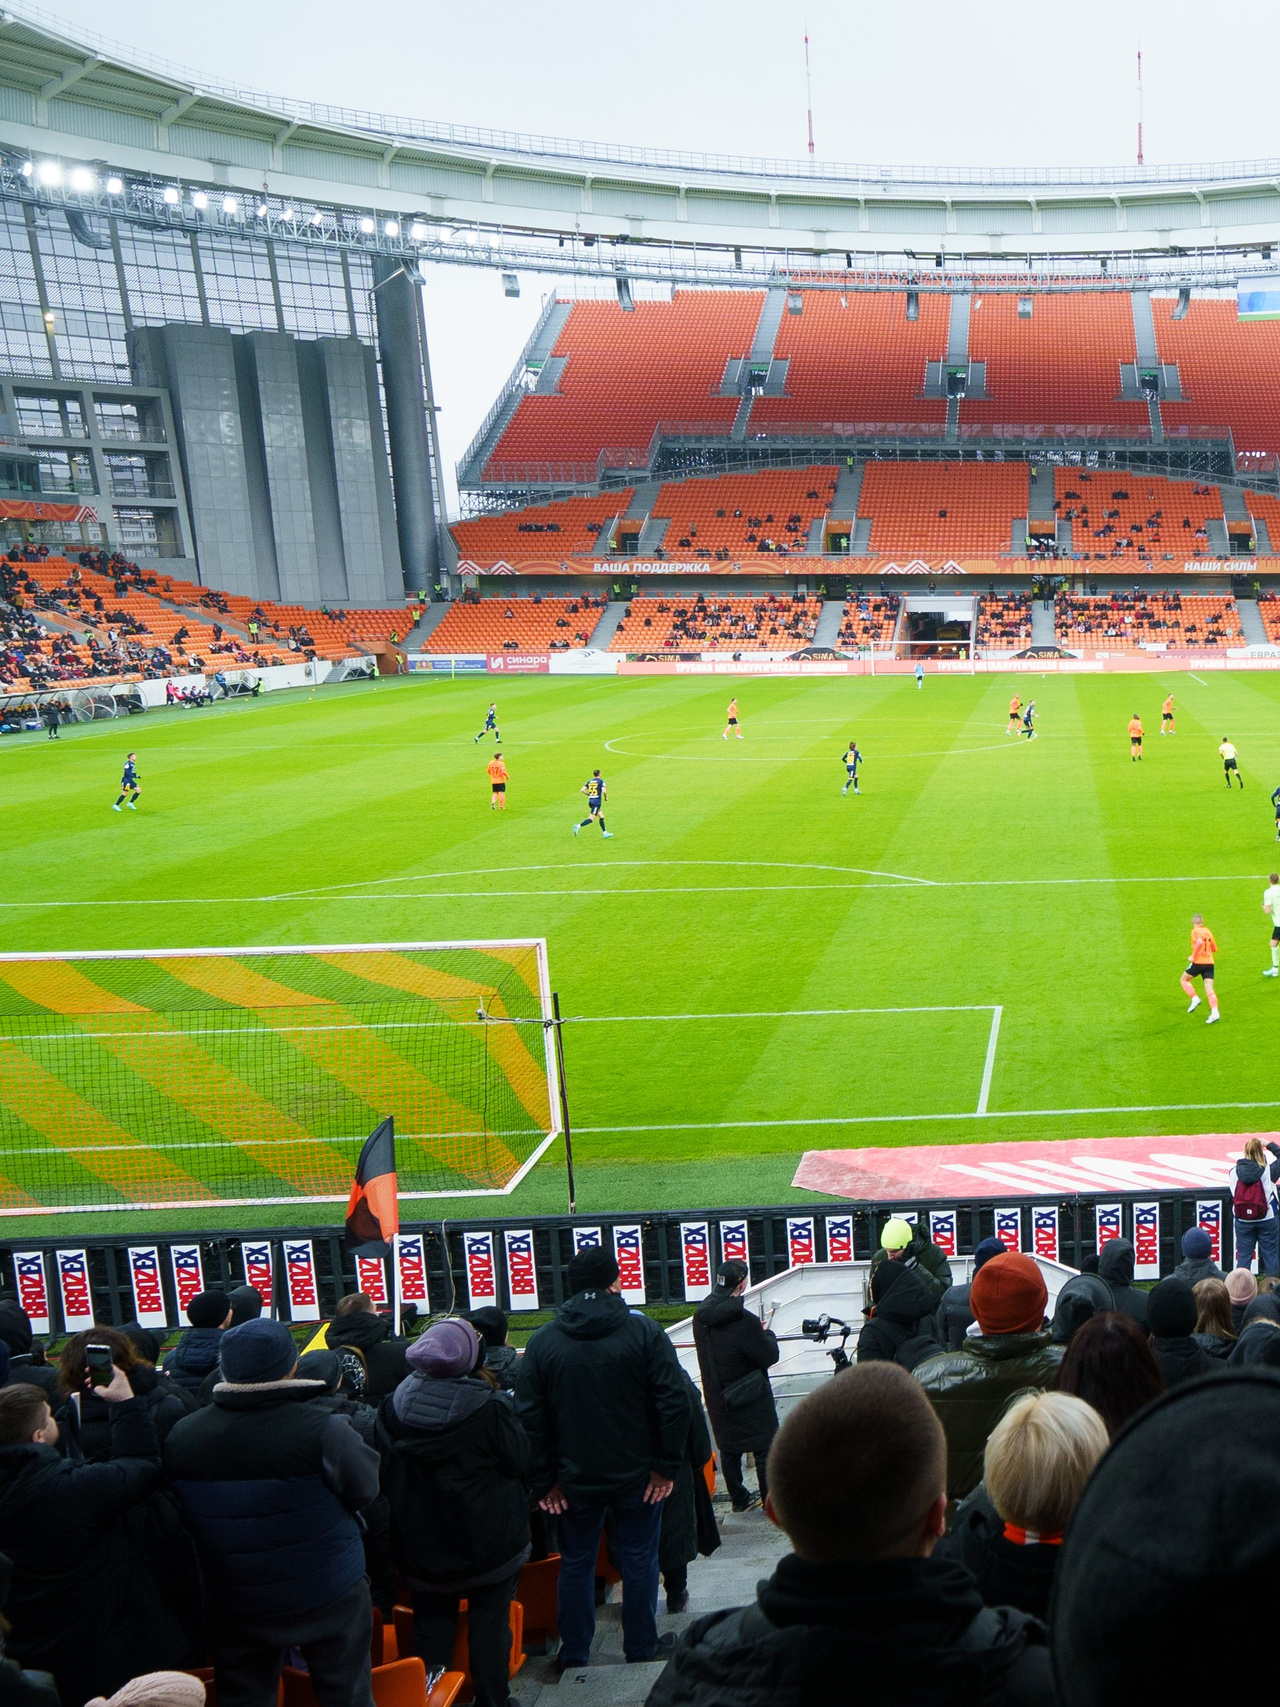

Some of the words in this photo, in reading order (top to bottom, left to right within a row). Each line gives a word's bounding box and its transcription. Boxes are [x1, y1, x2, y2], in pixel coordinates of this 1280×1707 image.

[593, 563, 630, 573] ВАША
[632, 563, 710, 574] ПОДДЕРЖКА
[1184, 562, 1221, 572] НАШИ
[1223, 562, 1257, 572] СИЛЫ
[466, 1234, 495, 1297] BROZEX
[507, 1232, 535, 1295] BROZEX
[616, 1228, 642, 1290] BROZEX
[683, 1223, 711, 1286] BROZEX
[1035, 1210, 1057, 1262] ROZEX
[1135, 1205, 1157, 1264] BROZEX
[16, 1254, 48, 1318] BROZEX
[60, 1252, 90, 1316] BROZEX
[131, 1250, 162, 1313] BROZEX
[286, 1243, 315, 1306] BROZEX
[398, 1237, 426, 1300] BROZEX
[573, 1674, 588, 1685] 5
